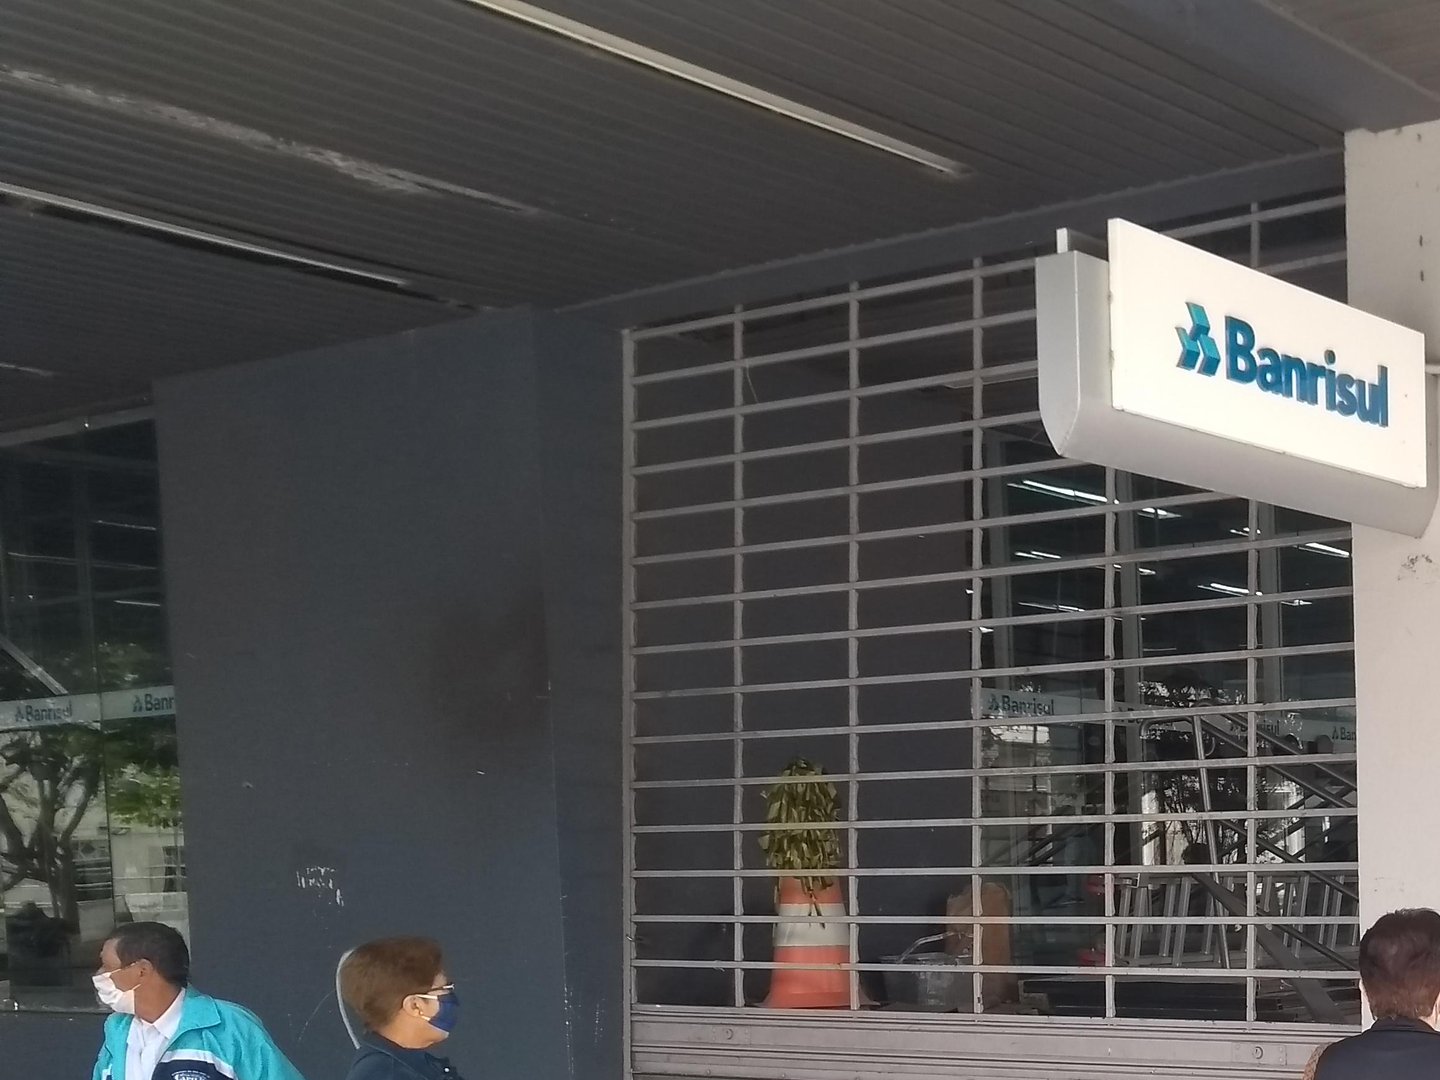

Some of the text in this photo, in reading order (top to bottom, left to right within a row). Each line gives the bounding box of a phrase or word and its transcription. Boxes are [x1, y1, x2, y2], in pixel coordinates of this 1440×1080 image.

[1225, 315, 1389, 428] Banrisul
[25, 701, 72, 722] Banrisul
[144, 693, 174, 712] Banr
[1001, 694, 1055, 716] Banrisul
